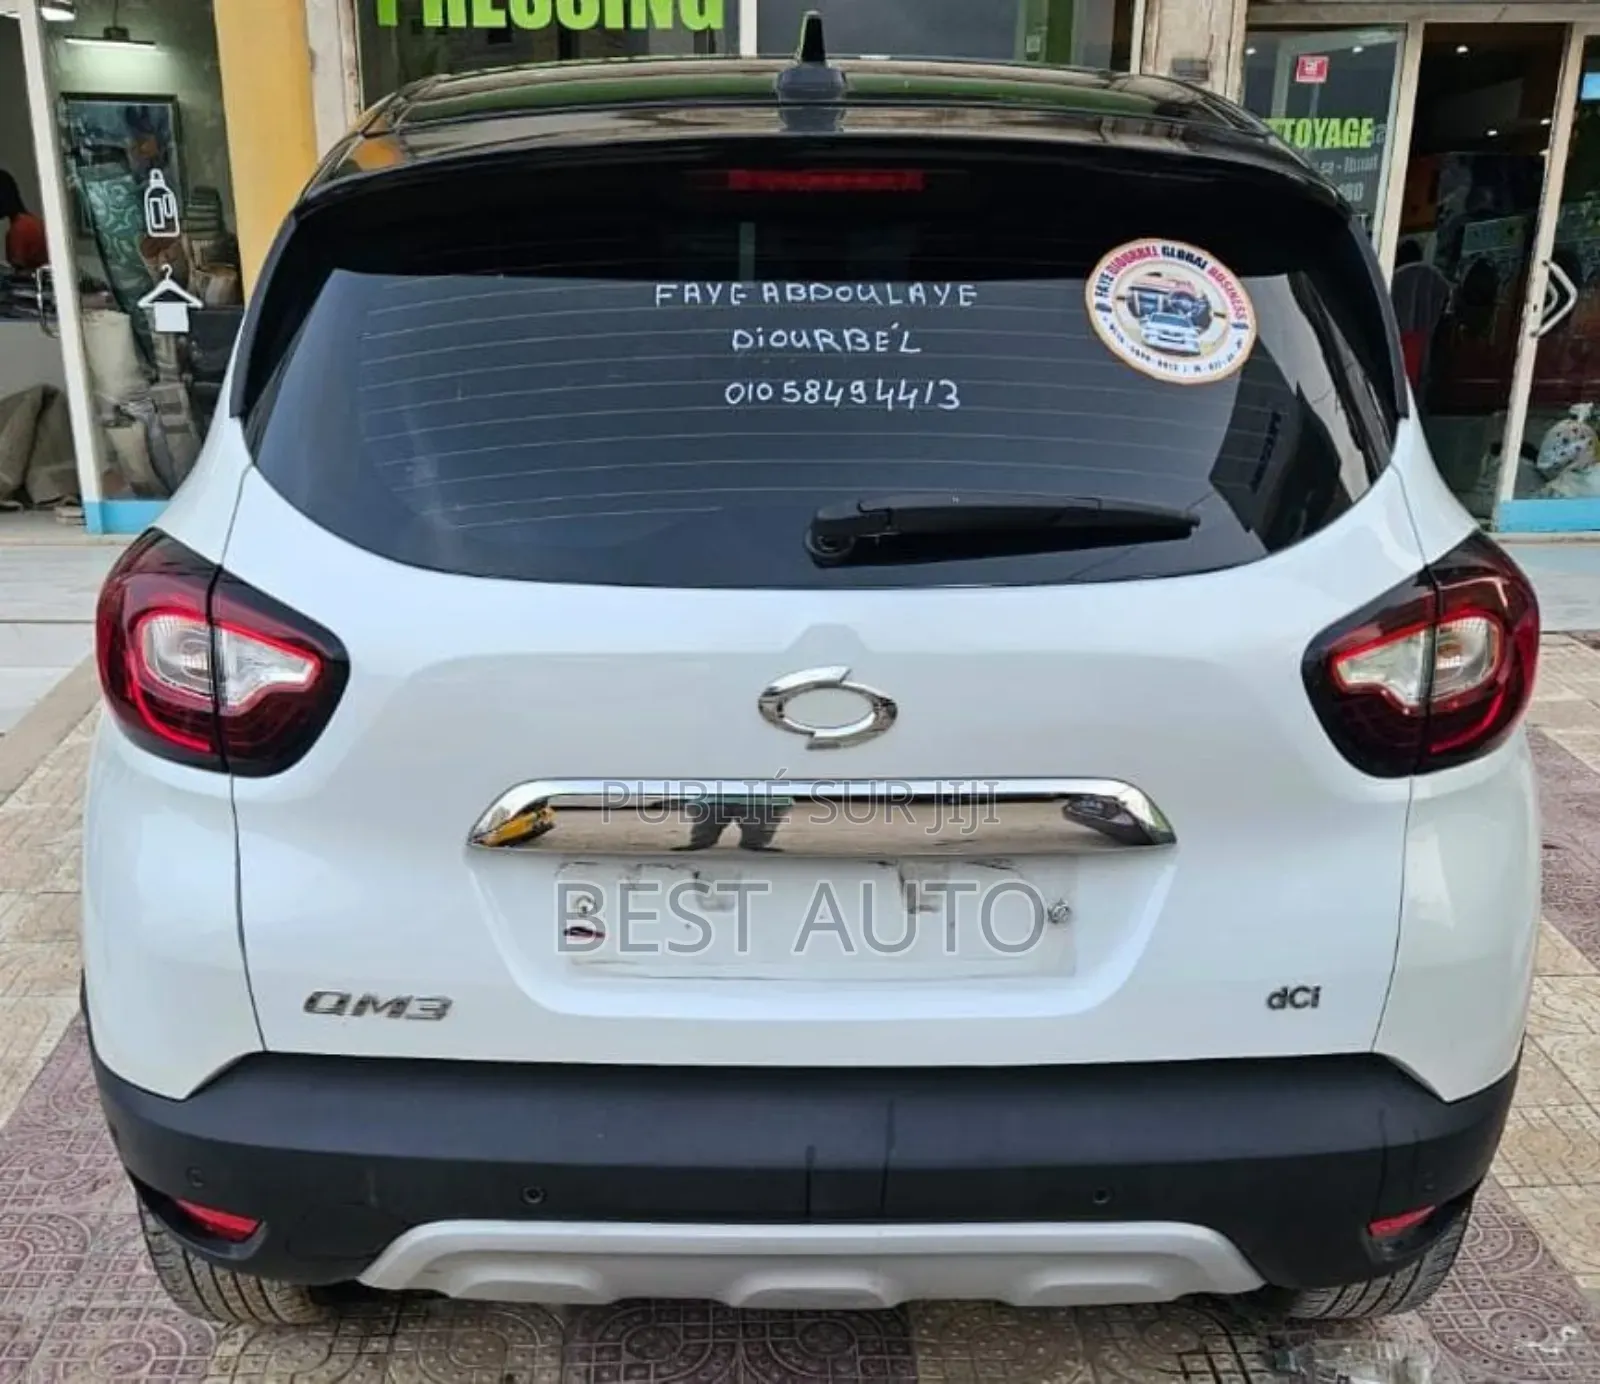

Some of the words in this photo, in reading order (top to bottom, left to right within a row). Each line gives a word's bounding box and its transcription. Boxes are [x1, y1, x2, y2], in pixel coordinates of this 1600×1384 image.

[377, 0, 724, 31] ESSING
[655, 282, 748, 307] FAYE
[762, 282, 978, 307] ABDOULAYE
[303, 991, 453, 1021] QM3
